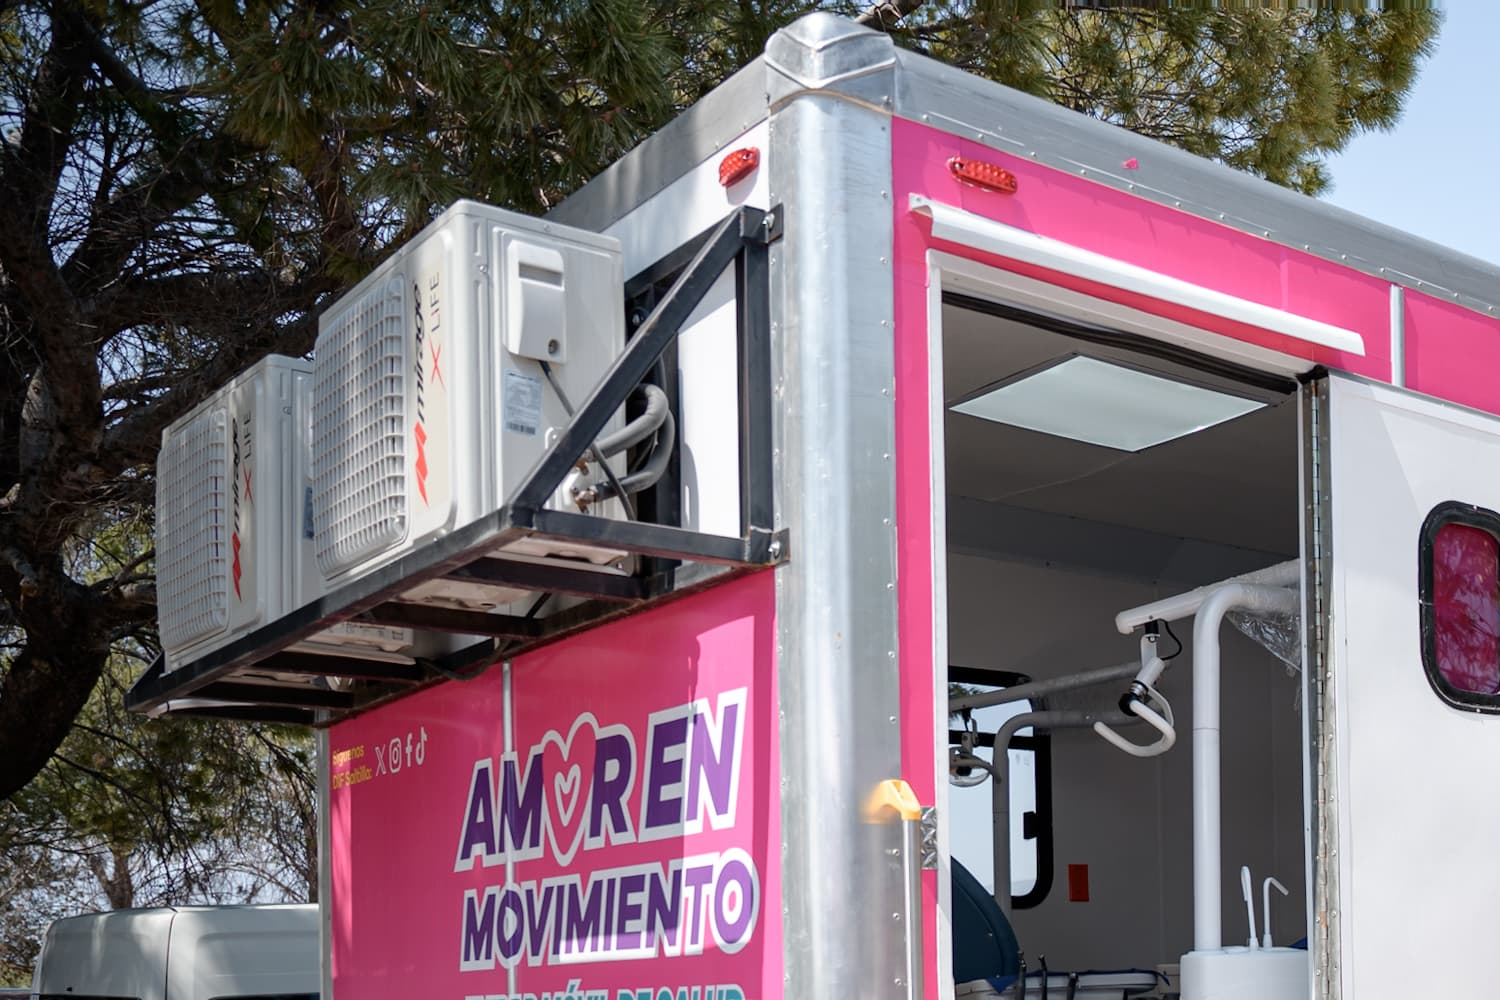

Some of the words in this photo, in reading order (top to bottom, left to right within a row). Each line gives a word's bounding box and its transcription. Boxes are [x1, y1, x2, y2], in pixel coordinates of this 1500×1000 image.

[413, 280, 426, 424] mirage
[641, 690, 746, 840] EN
[461, 850, 759, 970] MOVIMIENTO
